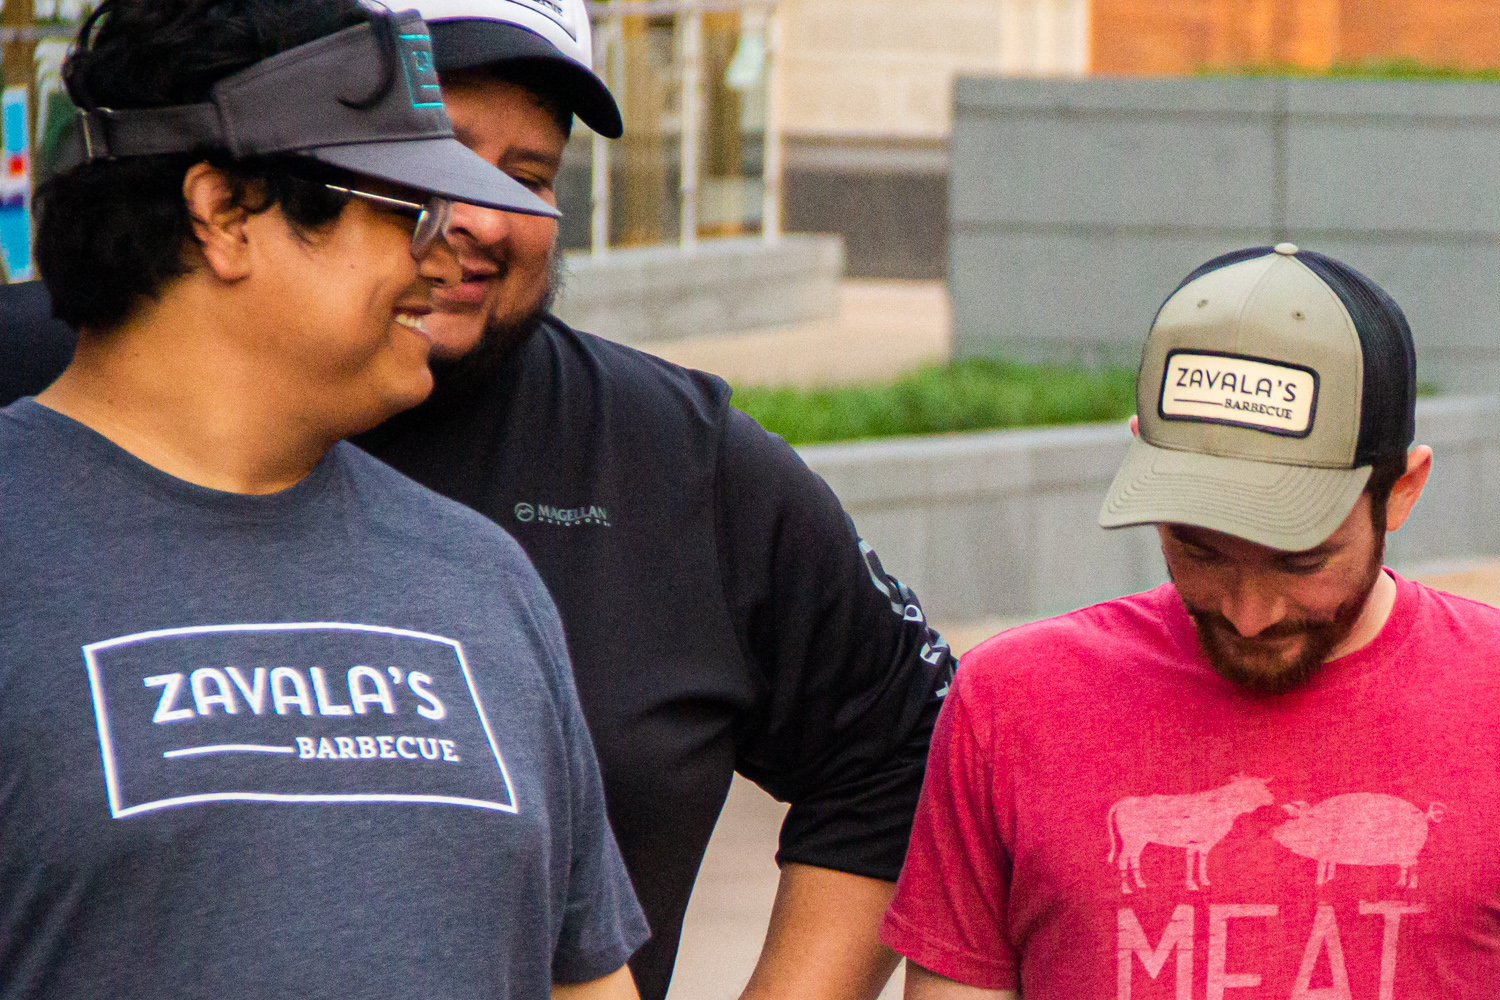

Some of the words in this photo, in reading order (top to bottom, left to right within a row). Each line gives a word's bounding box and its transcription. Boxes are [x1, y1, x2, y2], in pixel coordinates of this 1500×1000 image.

[1176, 367, 1297, 402] ZAVALA'S
[1224, 399, 1293, 420] BARBECUE
[538, 504, 607, 521] MAGELLAN
[143, 666, 447, 724] ZAVALA'S
[295, 736, 460, 762] BARBECUE
